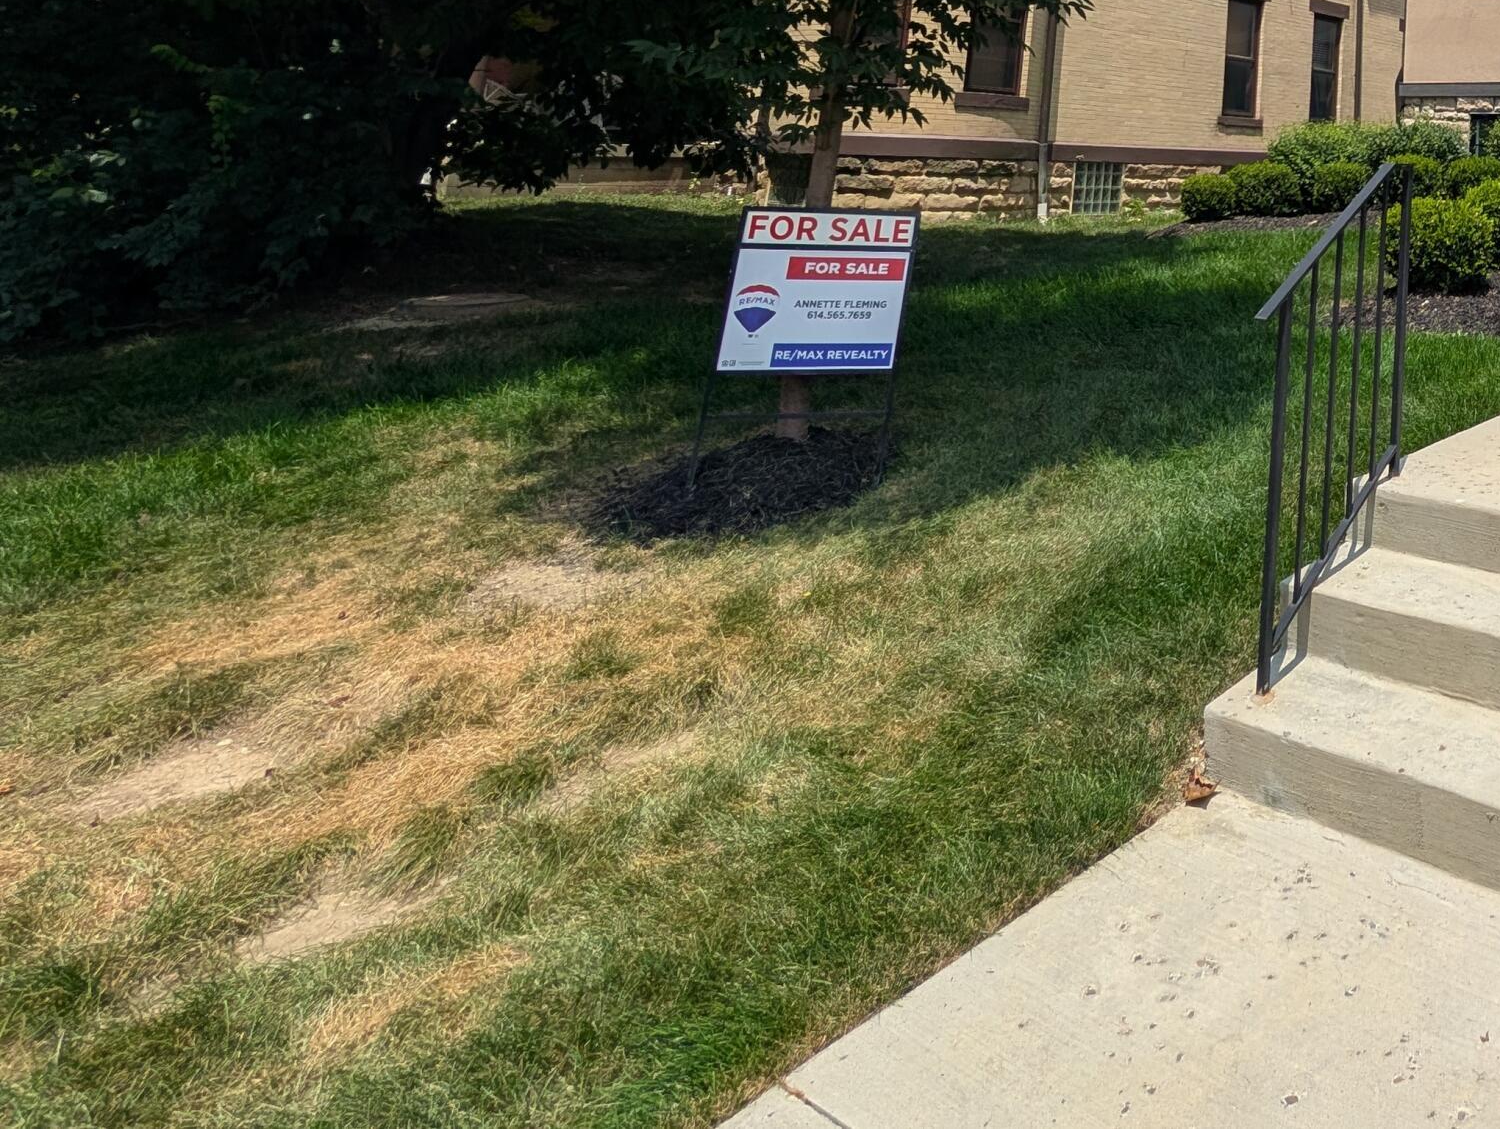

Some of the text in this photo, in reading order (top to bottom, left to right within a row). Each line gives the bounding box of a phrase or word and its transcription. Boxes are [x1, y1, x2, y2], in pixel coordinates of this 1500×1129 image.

[748, 215, 912, 243] FOR SALE
[804, 262, 889, 276] FOR SALE
[738, 296, 776, 306] RE/MAX
[794, 300, 888, 309] ANNETTE FLEMING
[807, 311, 872, 320] 614.565.7659
[774, 349, 889, 361] RE/MAX REVEALTY
